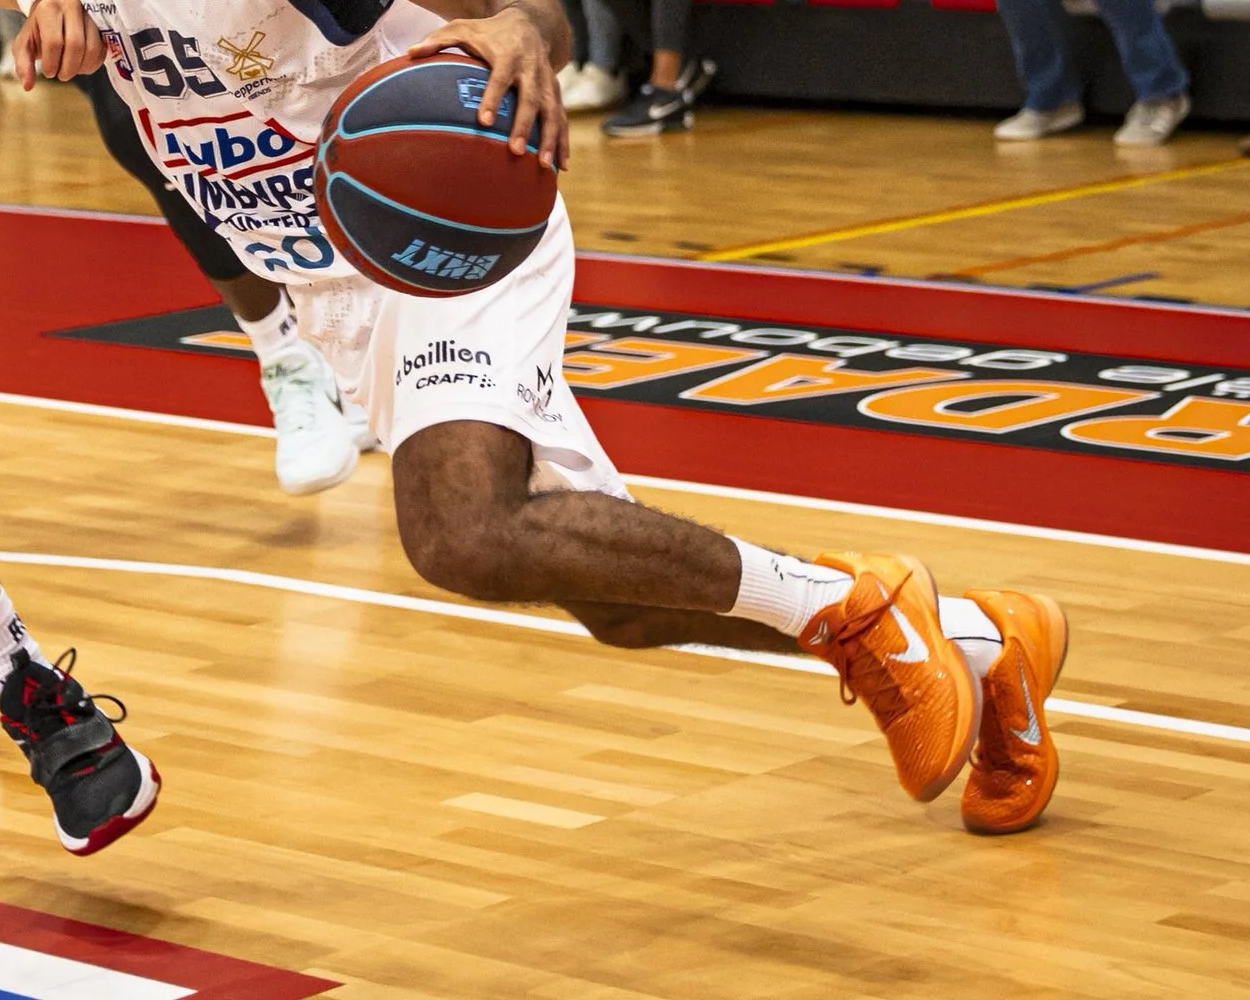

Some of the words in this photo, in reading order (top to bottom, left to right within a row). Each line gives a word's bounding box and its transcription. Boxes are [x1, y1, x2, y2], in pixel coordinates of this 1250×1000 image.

[128, 28, 226, 99] 55
[403, 340, 491, 376] baillien
[416, 374, 478, 389] CRAFT
